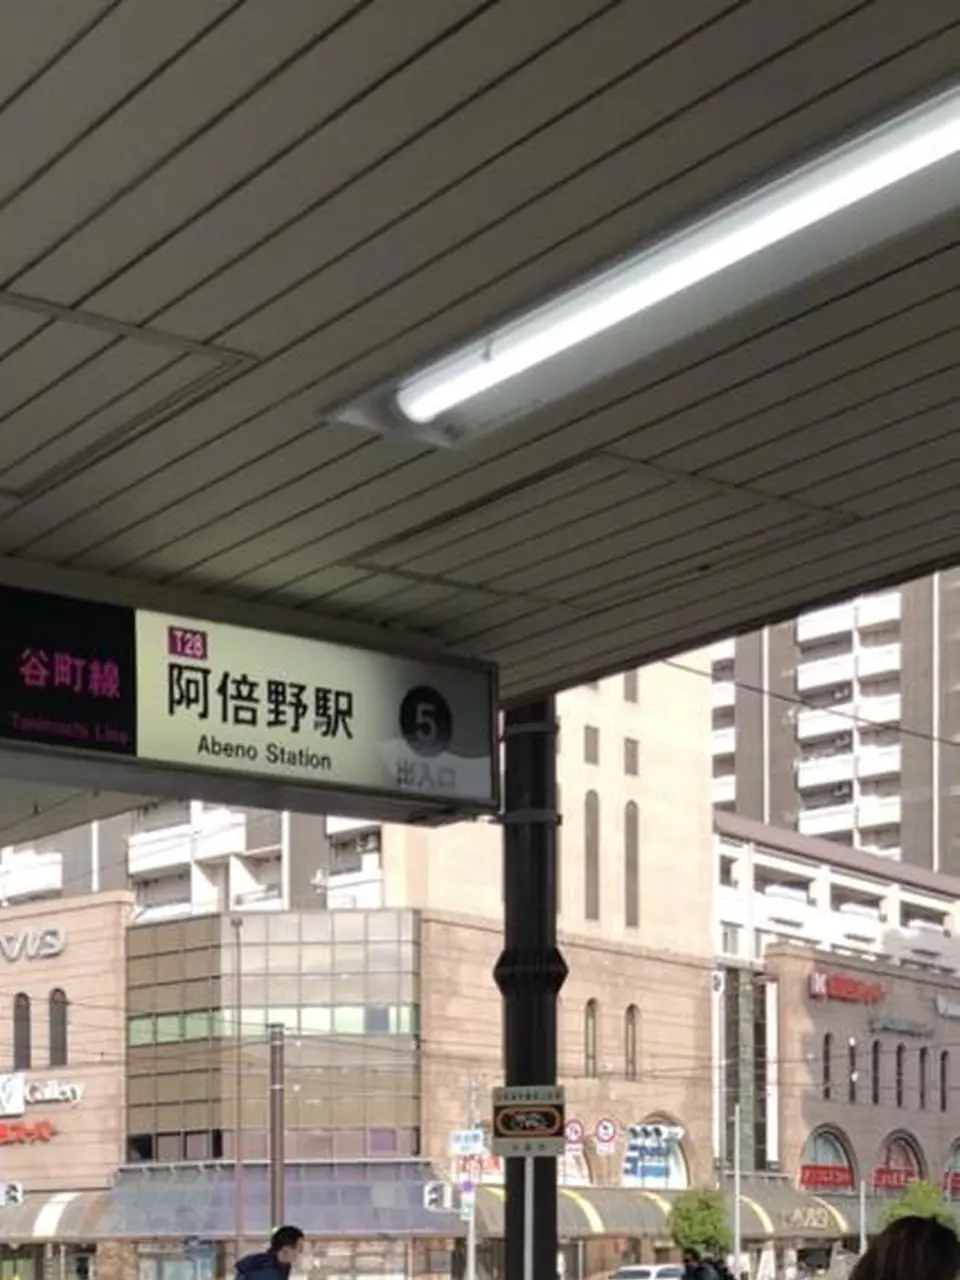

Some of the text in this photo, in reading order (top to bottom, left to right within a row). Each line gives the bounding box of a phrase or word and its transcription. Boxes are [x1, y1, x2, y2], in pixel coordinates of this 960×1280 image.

[171, 629, 204, 656] T28
[18, 648, 122, 699] 谷町線
[167, 662, 355, 740] 阿倍野駅
[414, 702, 437, 742] 5
[197, 734, 332, 771] Abeno Station
[396, 759, 457, 790] 出入口
